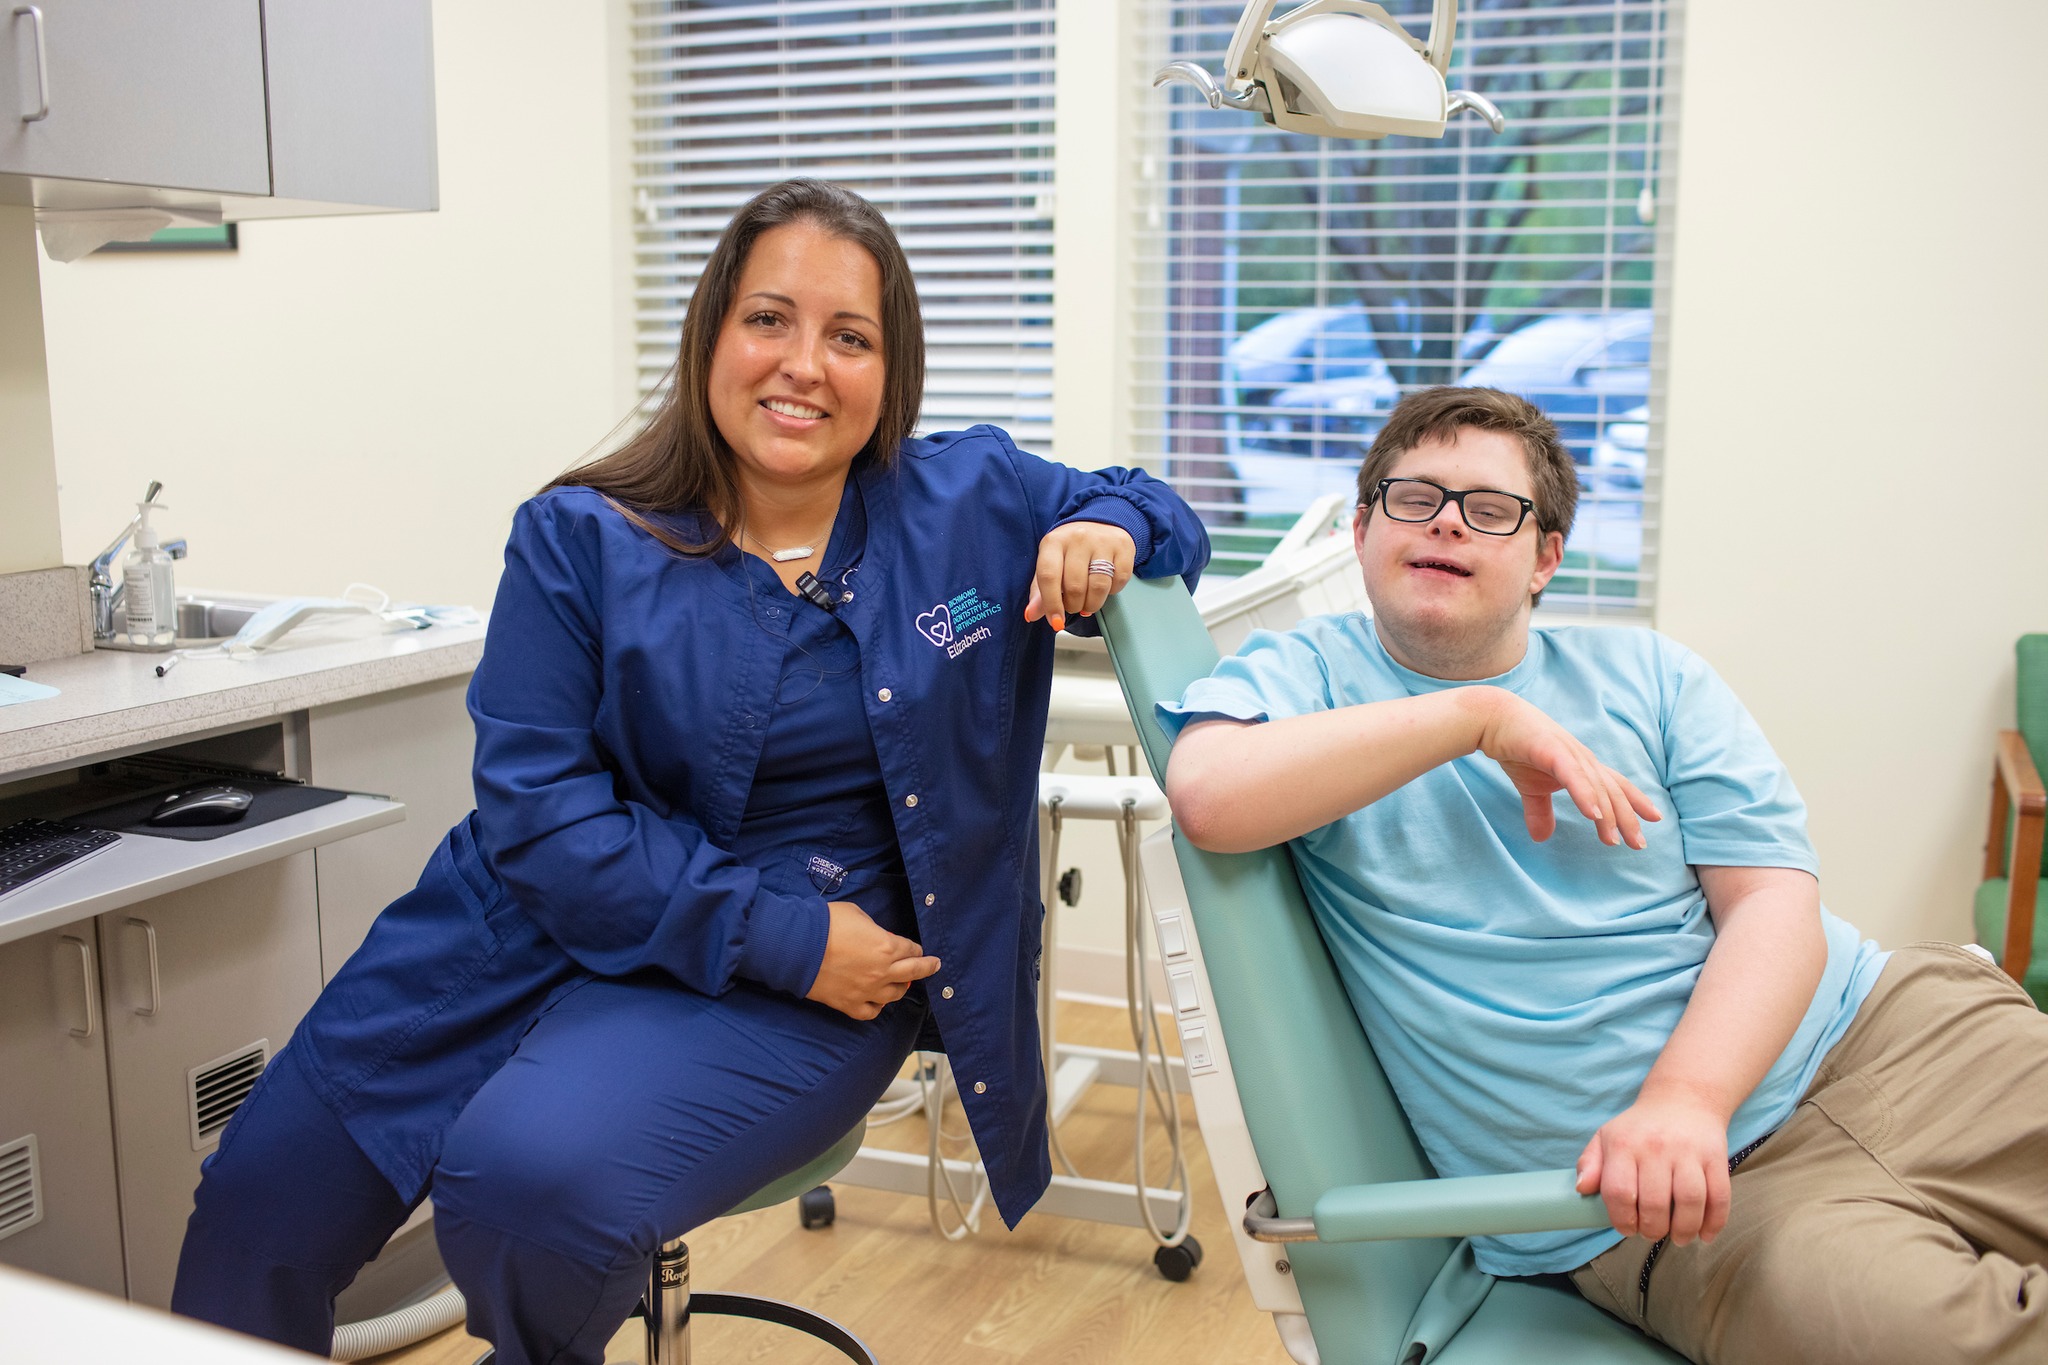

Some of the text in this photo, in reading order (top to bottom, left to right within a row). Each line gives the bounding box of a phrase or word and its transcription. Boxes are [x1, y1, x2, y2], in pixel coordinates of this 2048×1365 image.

[948, 587, 977, 608] RICHMOND
[950, 596, 979, 617] PEDIATRIC
[952, 600, 990, 625] DENTISTRY &
[955, 603, 1002, 633] ORTHODONTICS
[946, 626, 992, 660] Elizabeth
